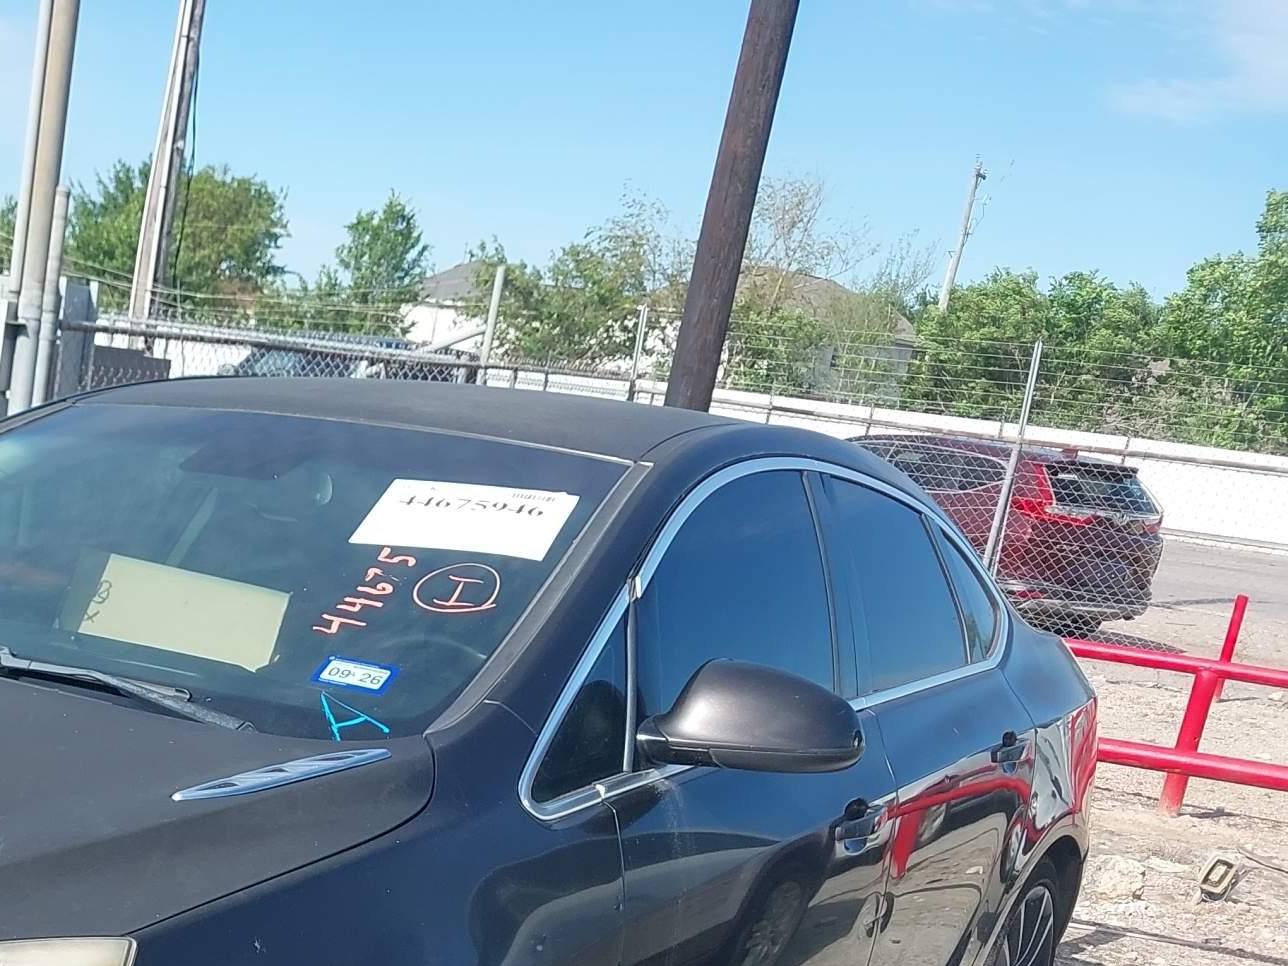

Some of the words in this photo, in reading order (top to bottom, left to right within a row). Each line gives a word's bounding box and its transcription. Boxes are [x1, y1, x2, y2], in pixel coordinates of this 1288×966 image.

[328, 666, 351, 679] 09
[358, 672, 383, 685] 26
[321, 690, 390, 741] A
